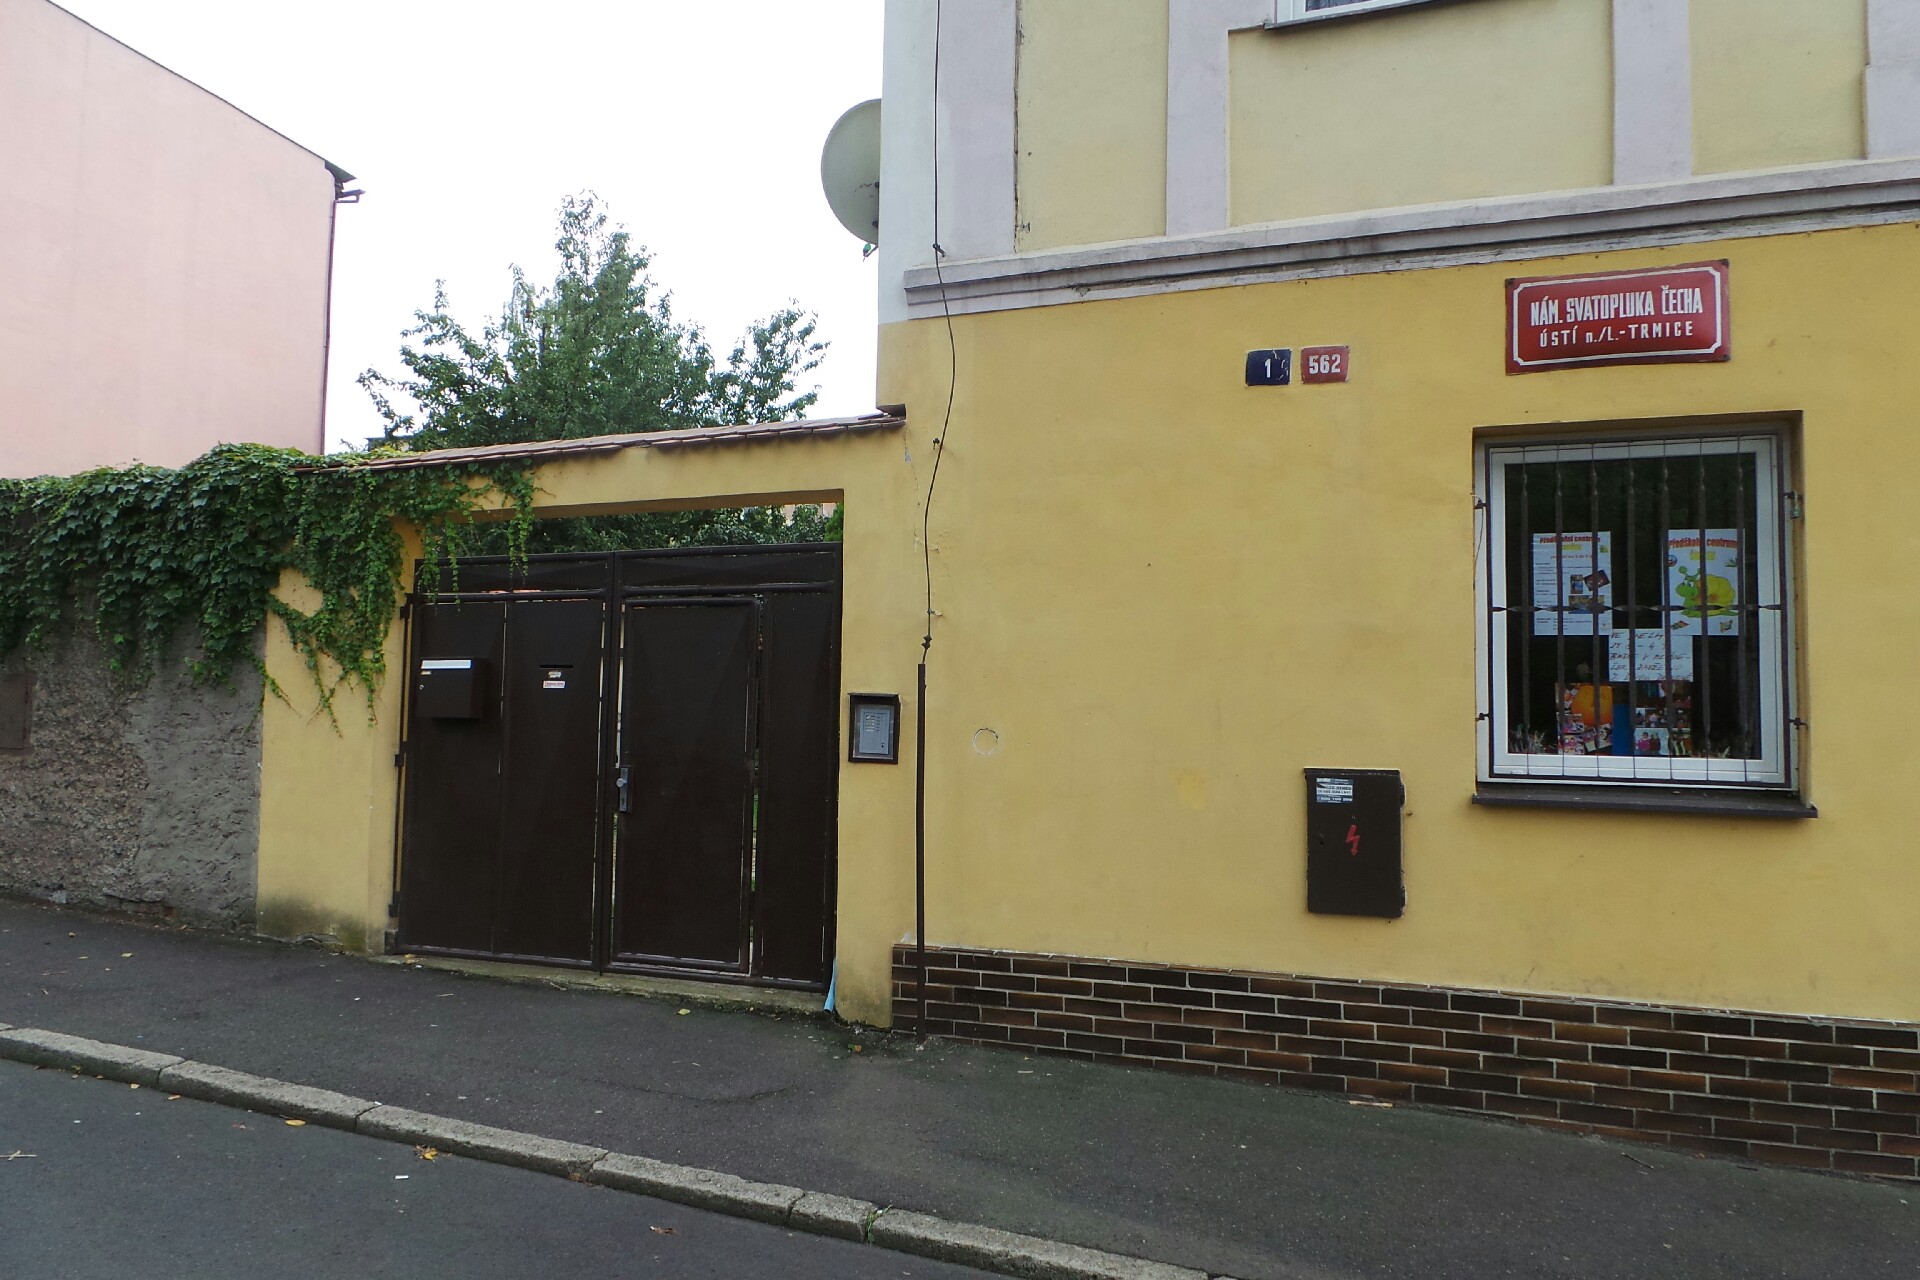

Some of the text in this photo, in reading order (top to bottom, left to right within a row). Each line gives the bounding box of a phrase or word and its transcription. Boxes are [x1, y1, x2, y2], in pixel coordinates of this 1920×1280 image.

[1530, 285, 1704, 327] NÁM. SVATOPLUKA ČECHA
[1539, 325, 1578, 348] ÚSTÍ
[1264, 358, 1271, 379] 1
[1308, 353, 1341, 375] 562
